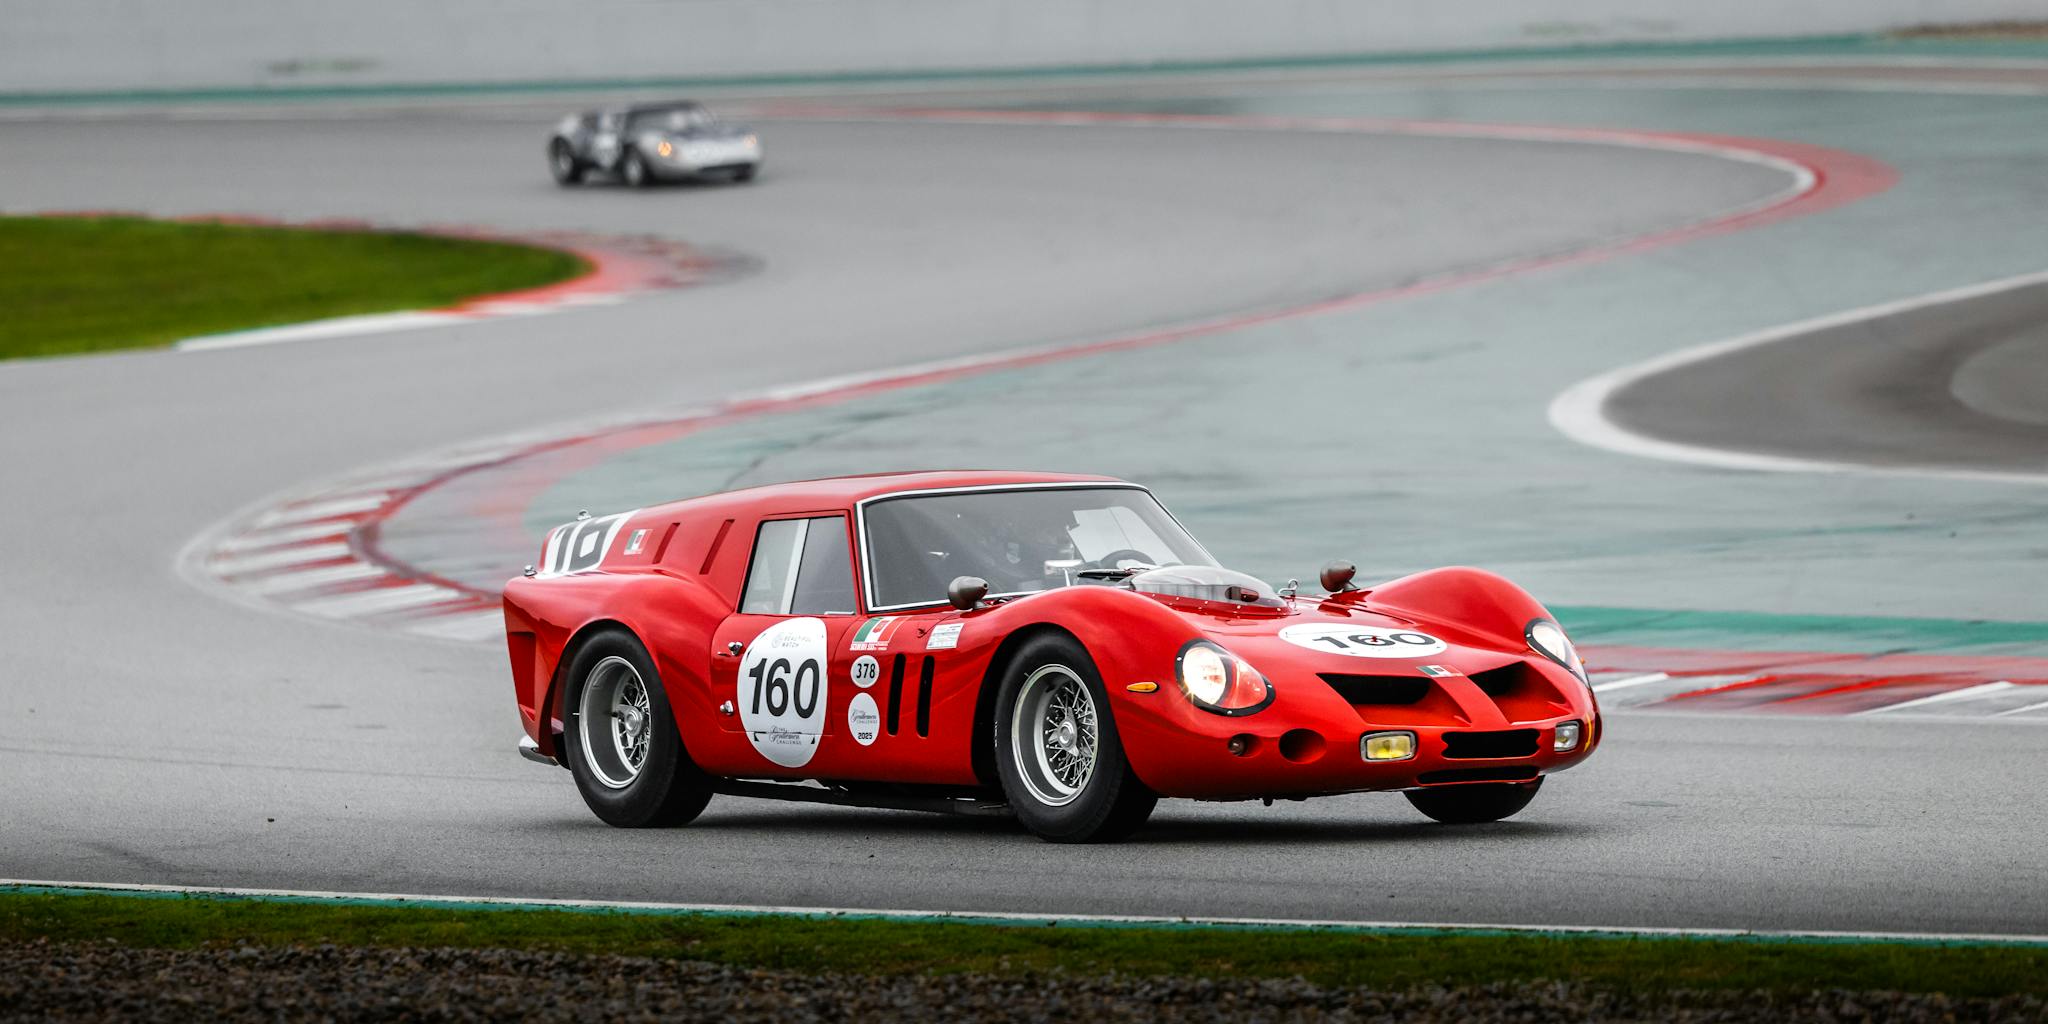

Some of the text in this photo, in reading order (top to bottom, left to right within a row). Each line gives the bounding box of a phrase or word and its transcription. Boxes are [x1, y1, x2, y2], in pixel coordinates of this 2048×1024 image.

[1312, 632, 1436, 649] 160
[856, 663, 876, 679] 378
[749, 657, 820, 719] 160
[857, 731, 873, 740] 2025
